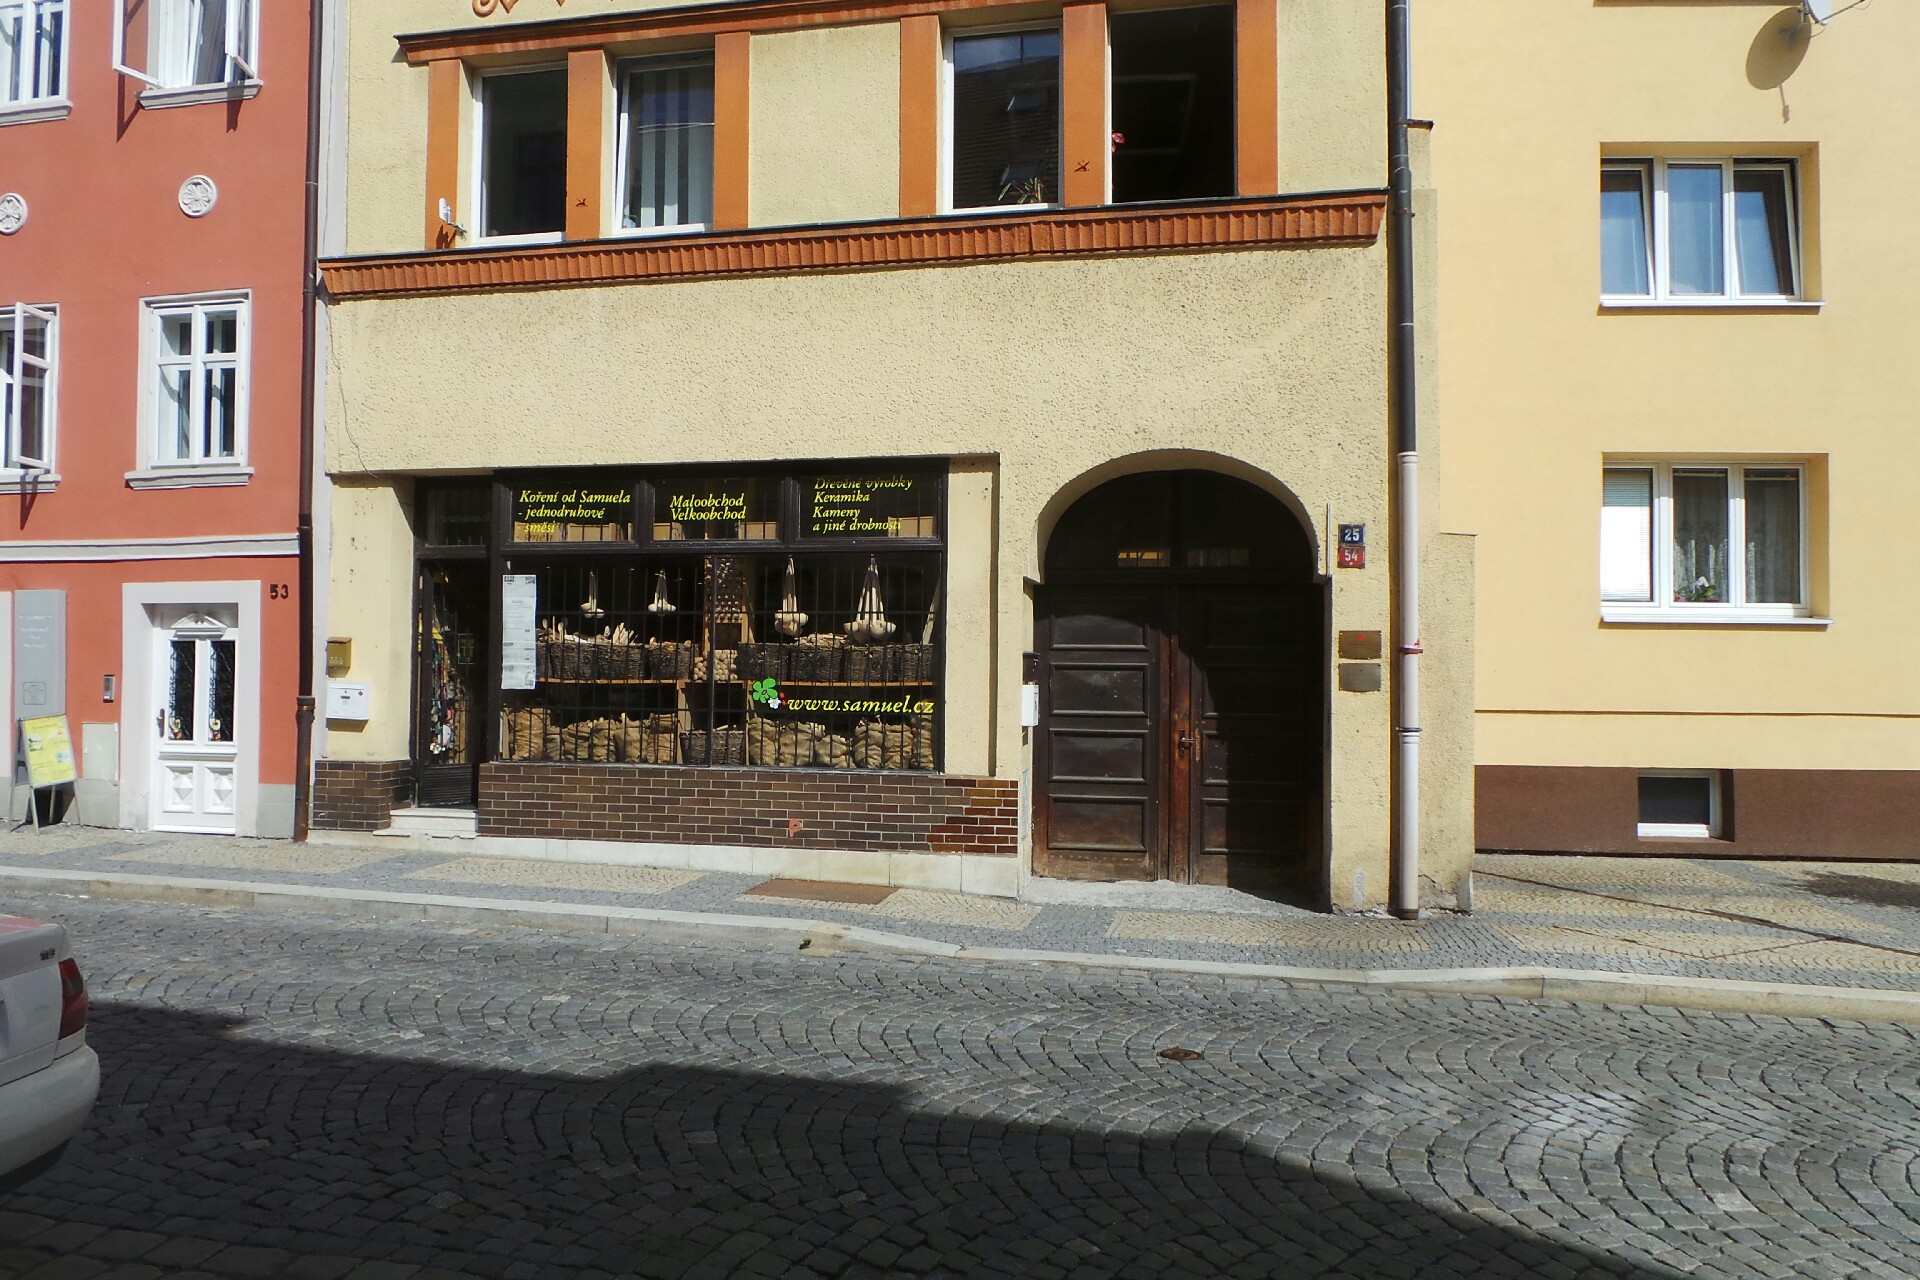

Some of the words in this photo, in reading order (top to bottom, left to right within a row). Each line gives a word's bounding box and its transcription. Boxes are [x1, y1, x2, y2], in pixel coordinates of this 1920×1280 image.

[865, 475, 913, 491] výrobky
[519, 490, 560, 503] Koření
[561, 490, 577, 503] od
[579, 489, 631, 504] Samuela
[669, 492, 745, 508] Maloobchod
[813, 490, 870, 503] Keramika
[524, 505, 606, 520] jednodruhové
[670, 505, 747, 521] Velkoobchod
[812, 506, 860, 520] Kameny
[812, 523, 820, 531] a
[822, 519, 846, 534] jiné
[849, 518, 902, 531] drobnosti
[1344, 528, 1360, 542] 25
[1344, 550, 1358, 562] 54
[269, 583, 289, 600] 53
[787, 694, 935, 714] www.samuel.cz
